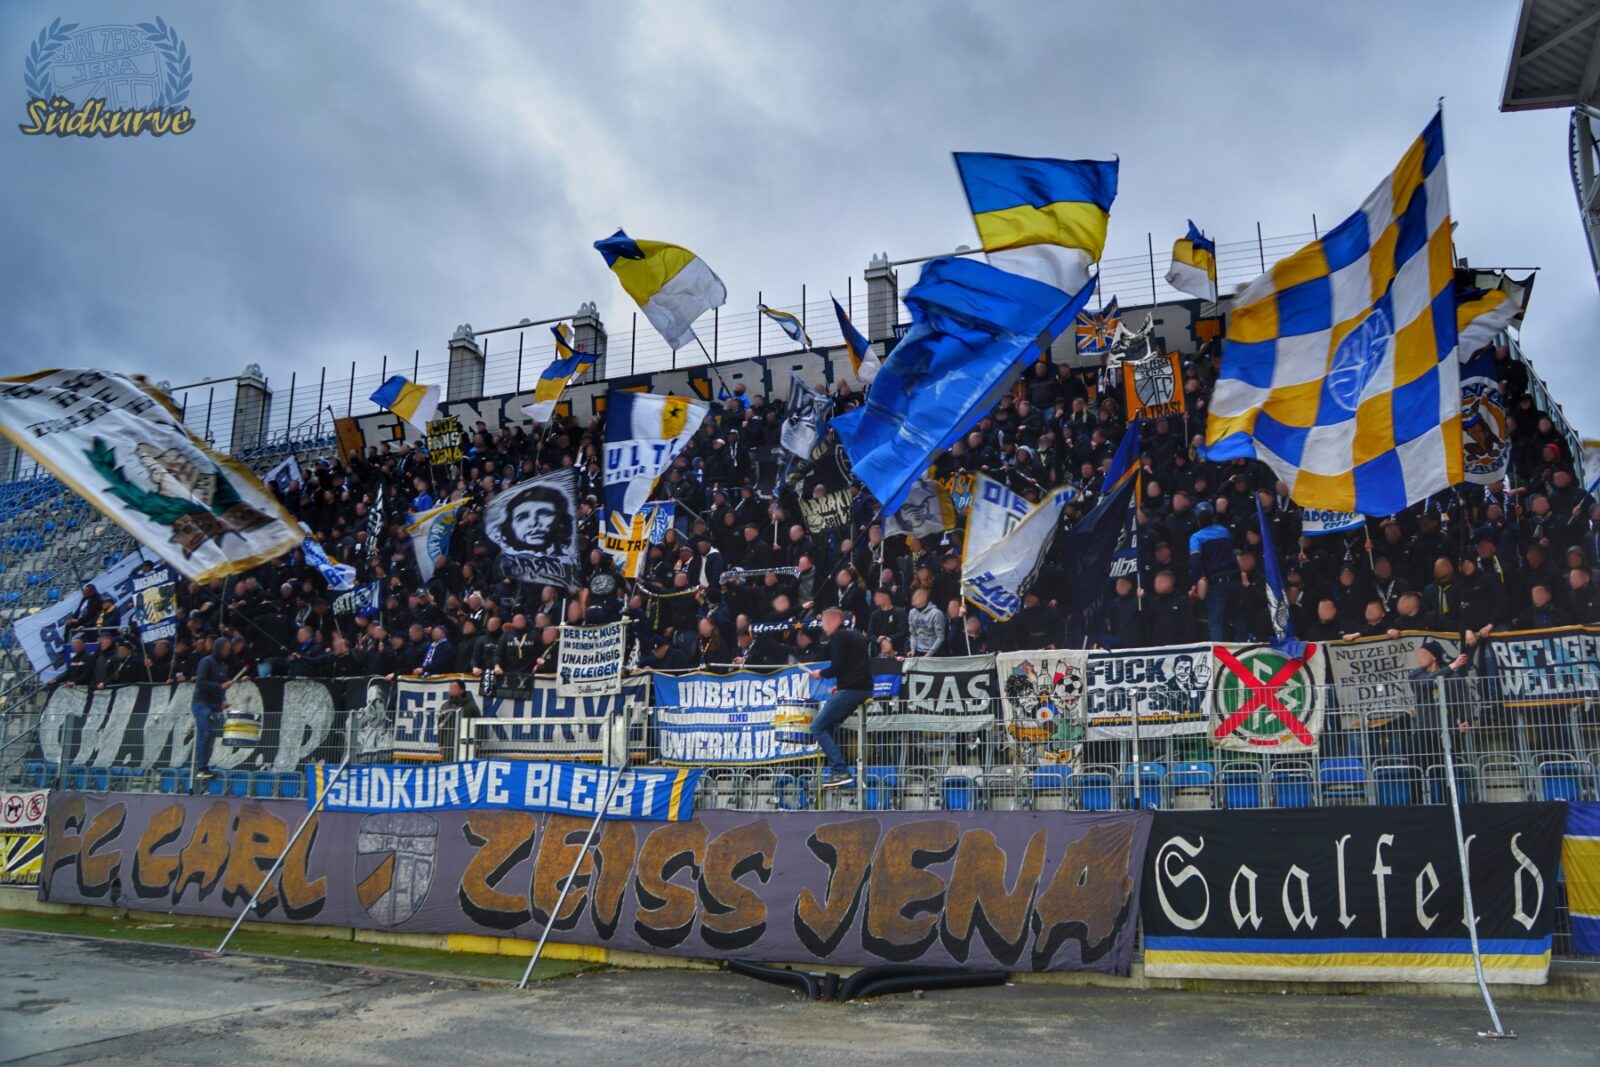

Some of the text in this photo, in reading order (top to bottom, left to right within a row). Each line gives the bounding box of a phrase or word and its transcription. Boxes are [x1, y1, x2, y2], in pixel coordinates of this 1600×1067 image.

[563, 624, 620, 639] DER FCC MUSS
[562, 649, 620, 665] UNABHÄNGIG
[1336, 641, 1415, 661] NUTZE DAS
[573, 662, 619, 678] BLEIBEN
[1086, 658, 1168, 686] FUCK
[1350, 655, 1405, 675] SPIEL
[1358, 670, 1410, 684] KÖNNT
[678, 672, 811, 709] UNBEUGSAM
[1087, 684, 1169, 714] COPS
[1357, 682, 1405, 701] DEIN
[728, 713, 749, 722] UND
[328, 759, 666, 816] SÜDKURVE BLEIBT
[43, 801, 1132, 971] FC CARL ZEISS JENA
[1154, 831, 1545, 939] Saalfeld
